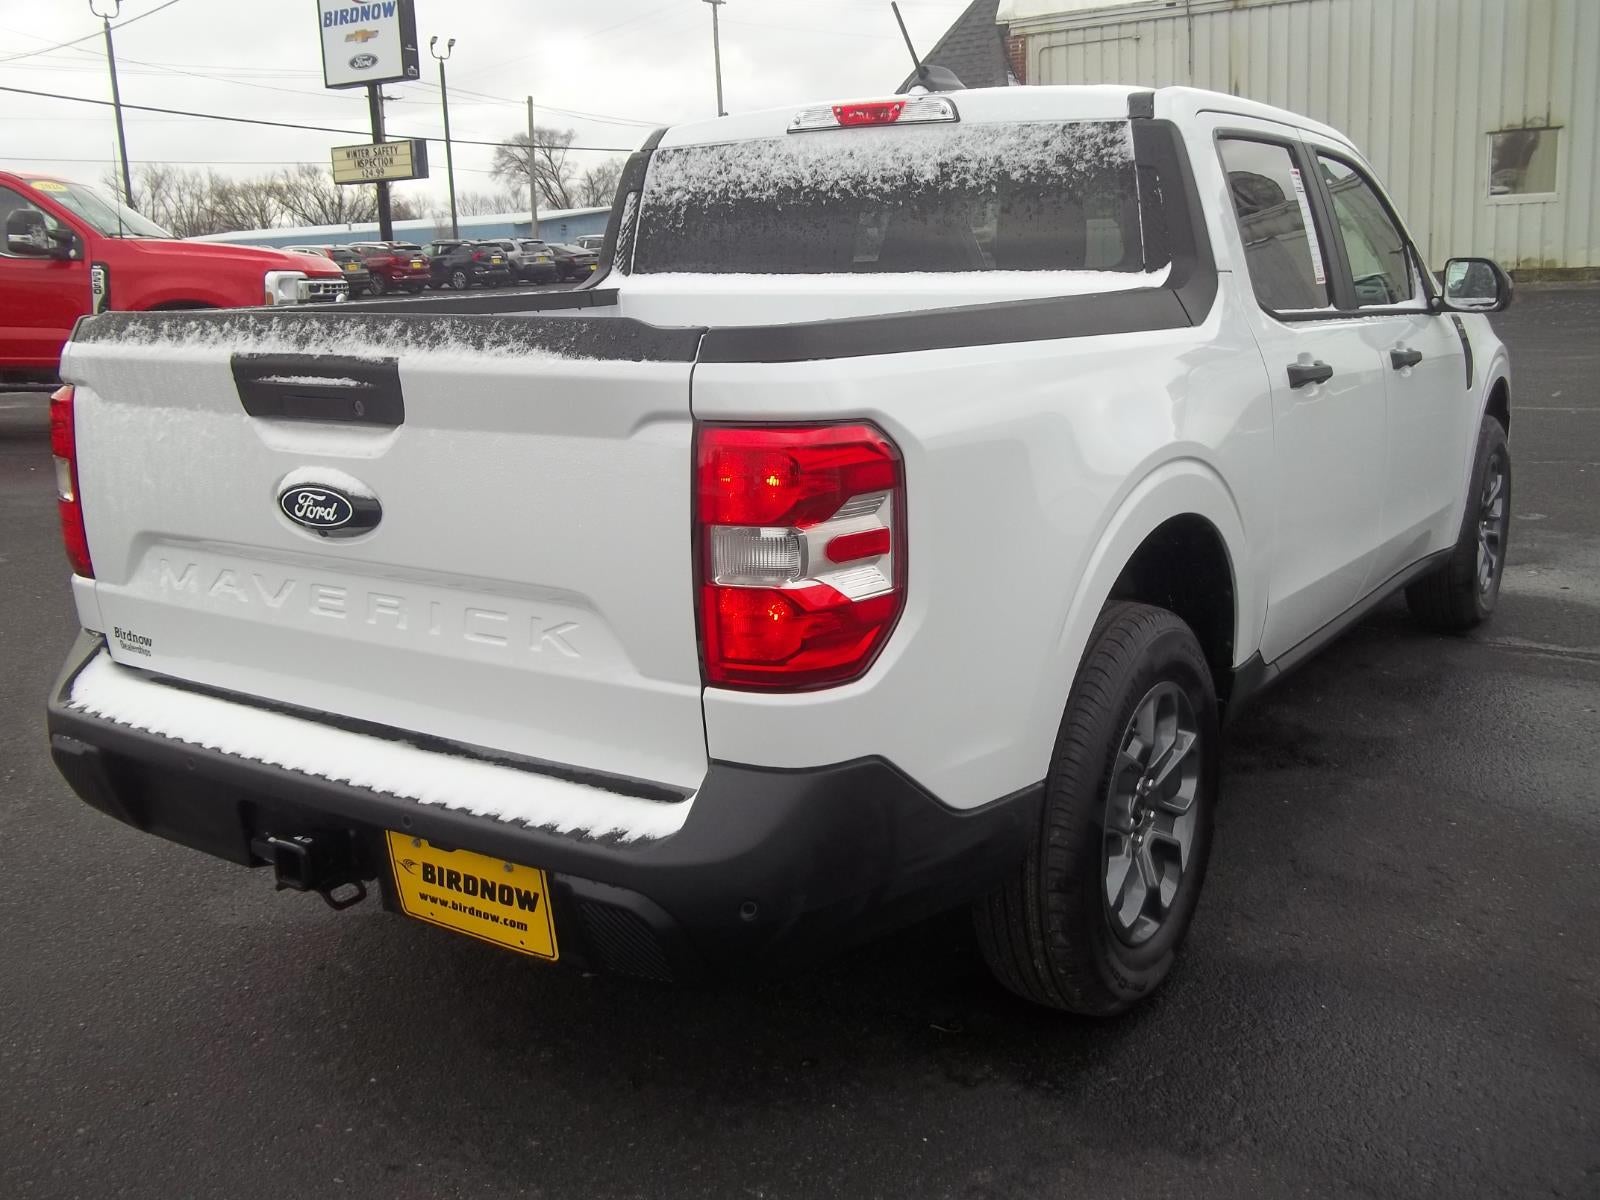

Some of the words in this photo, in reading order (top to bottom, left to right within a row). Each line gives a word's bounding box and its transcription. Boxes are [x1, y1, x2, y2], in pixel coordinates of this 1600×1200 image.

[323, 1, 396, 28] BIRDNOW
[353, 55, 374, 68] Ford
[346, 149, 370, 159] WINTER
[373, 145, 399, 157] SAFETY
[354, 157, 394, 169] INSPECTION
[294, 492, 338, 521] Ford
[158, 558, 582, 658] MAVERICK
[114, 626, 152, 647] Birdnow
[421, 861, 540, 913] BIRDNOW
[418, 891, 529, 932] www.birdnow.com
